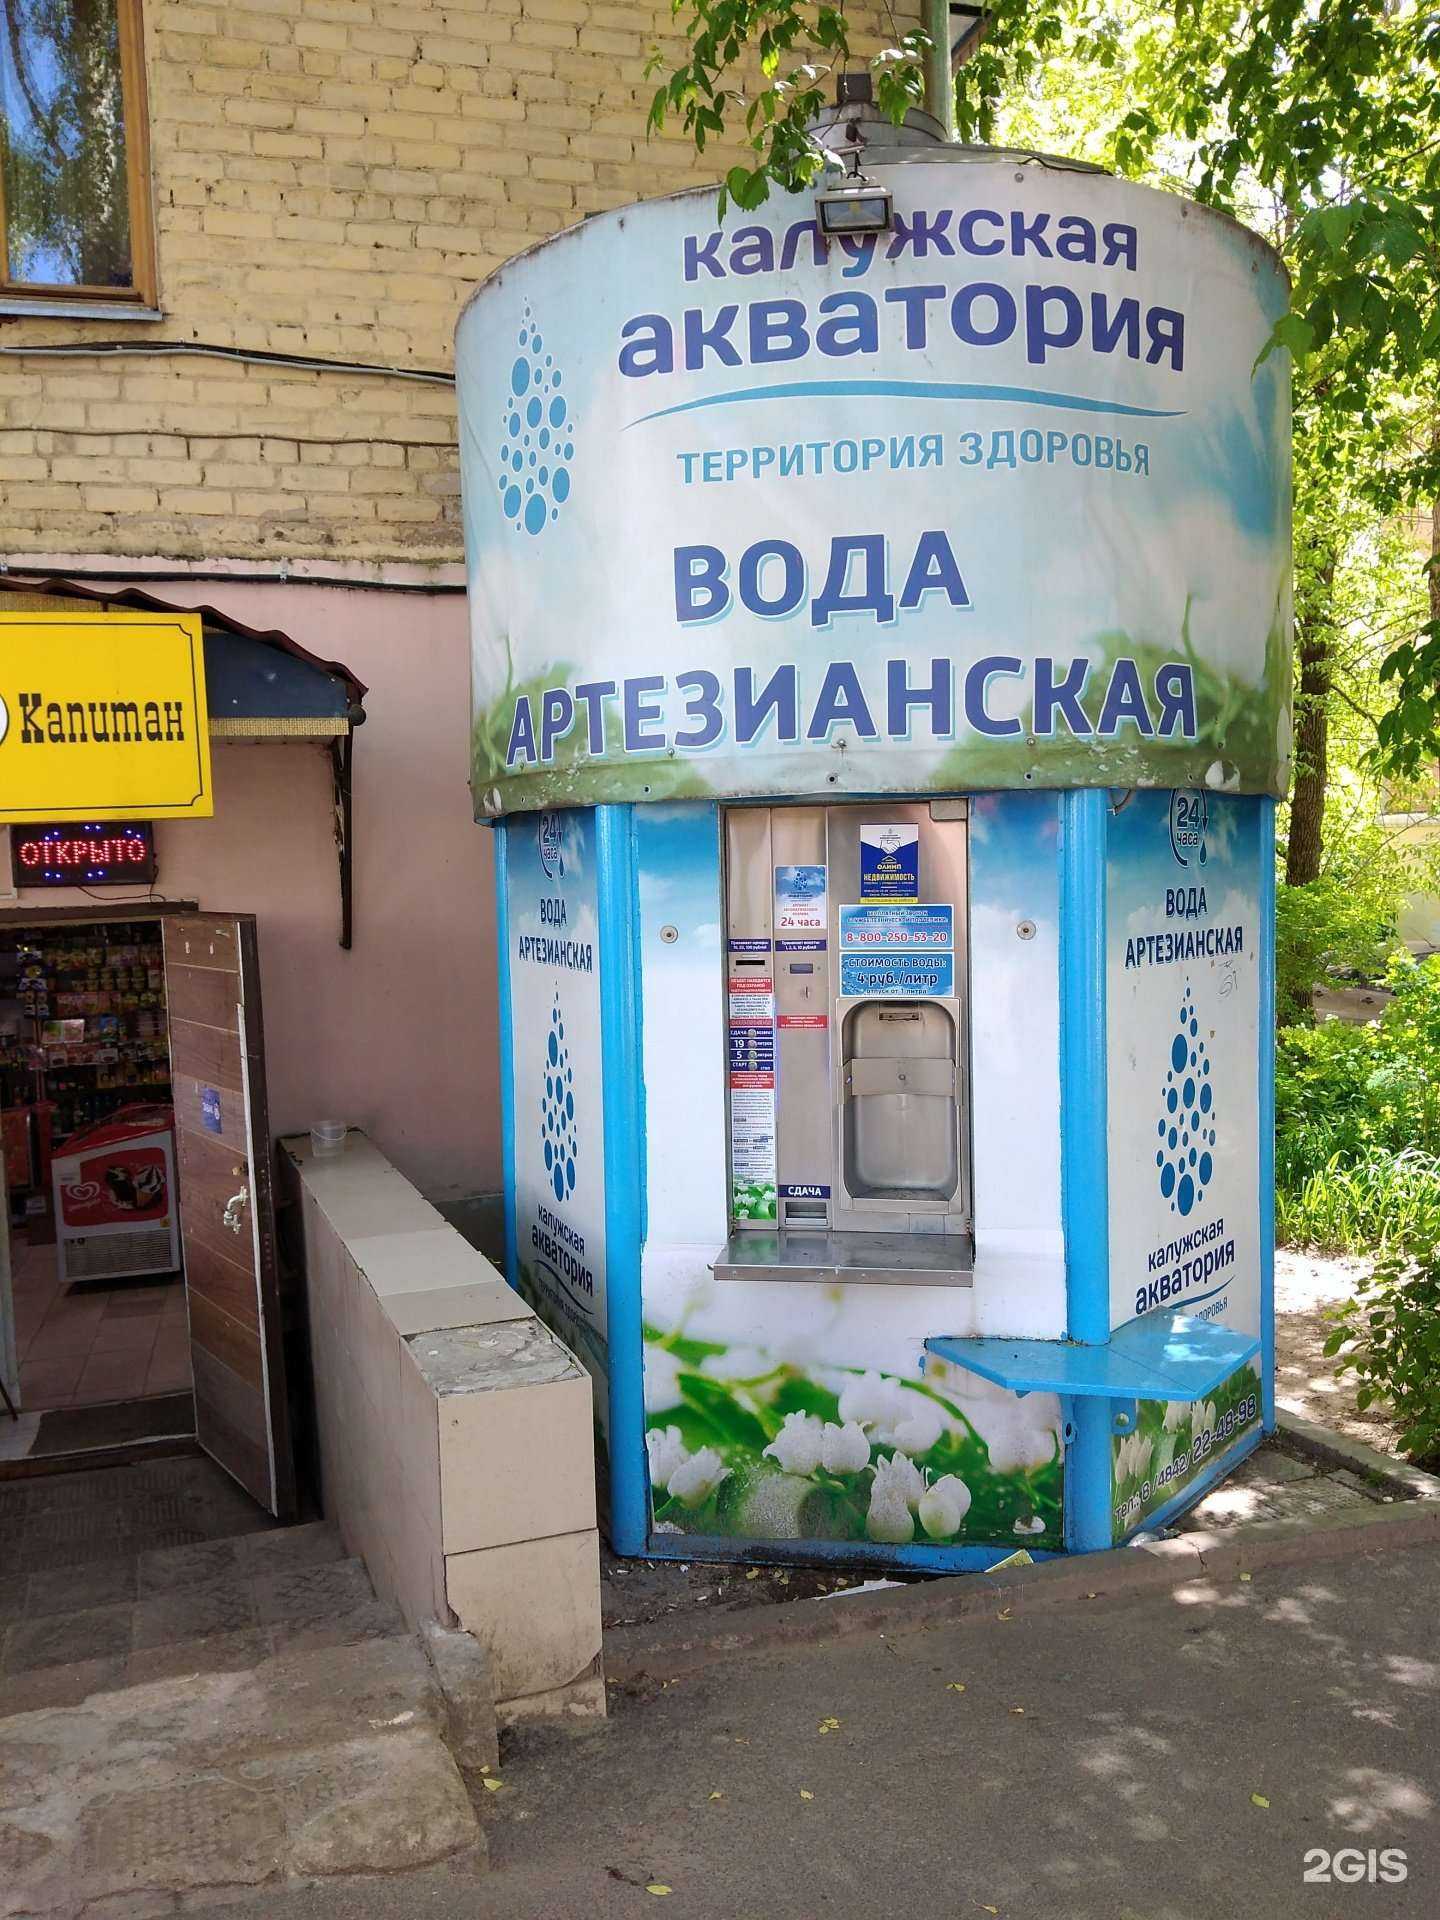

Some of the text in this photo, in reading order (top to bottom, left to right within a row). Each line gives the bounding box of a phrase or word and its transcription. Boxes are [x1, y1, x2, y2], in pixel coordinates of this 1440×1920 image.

[684, 209, 1138, 281] калужская
[618, 282, 1185, 378] акватория
[676, 430, 1150, 485] ТЕРРИТОРИЯ ЗДОРОВЬЯ
[673, 530, 973, 627] ВОДА
[18, 693, 185, 743] Капитан
[505, 655, 1198, 767] АРТЕЗИАНСКАЯ
[1176, 797, 1200, 829] 24
[542, 815, 557, 844] 24
[1176, 831, 1199, 846] часа
[20, 839, 146, 865] ОТКРЫТО
[543, 847, 558, 860] часа
[863, 873, 916, 881] НЕДВИЖИМОСТЬ
[540, 899, 568, 927] ВОДА
[1166, 887, 1208, 919] ВОДА
[780, 917, 821, 927] 24 часа
[847, 932, 948, 942] 8-800-250-53-20
[1125, 926, 1244, 968] АРТЕЗИАНСКАЯ
[519, 936, 592, 972] АРТЕЗИАНСКАЯ
[848, 958, 947, 969] СТОИМОСТЬ ВОДЫ:
[857, 972, 938, 986] 4 руб./литр
[735, 1039, 745, 1048] 19
[736, 1050, 743, 1060] 5
[787, 1185, 822, 1197] СДАЧА
[537, 1203, 585, 1256] калужская
[1148, 1218, 1224, 1272] калужская
[531, 1224, 594, 1297] акватория
[1135, 1240, 1235, 1314] акватория
[1194, 1296, 1228, 1321] ДОРОВЬЯ
[1141, 1481, 1151, 1502] 8
